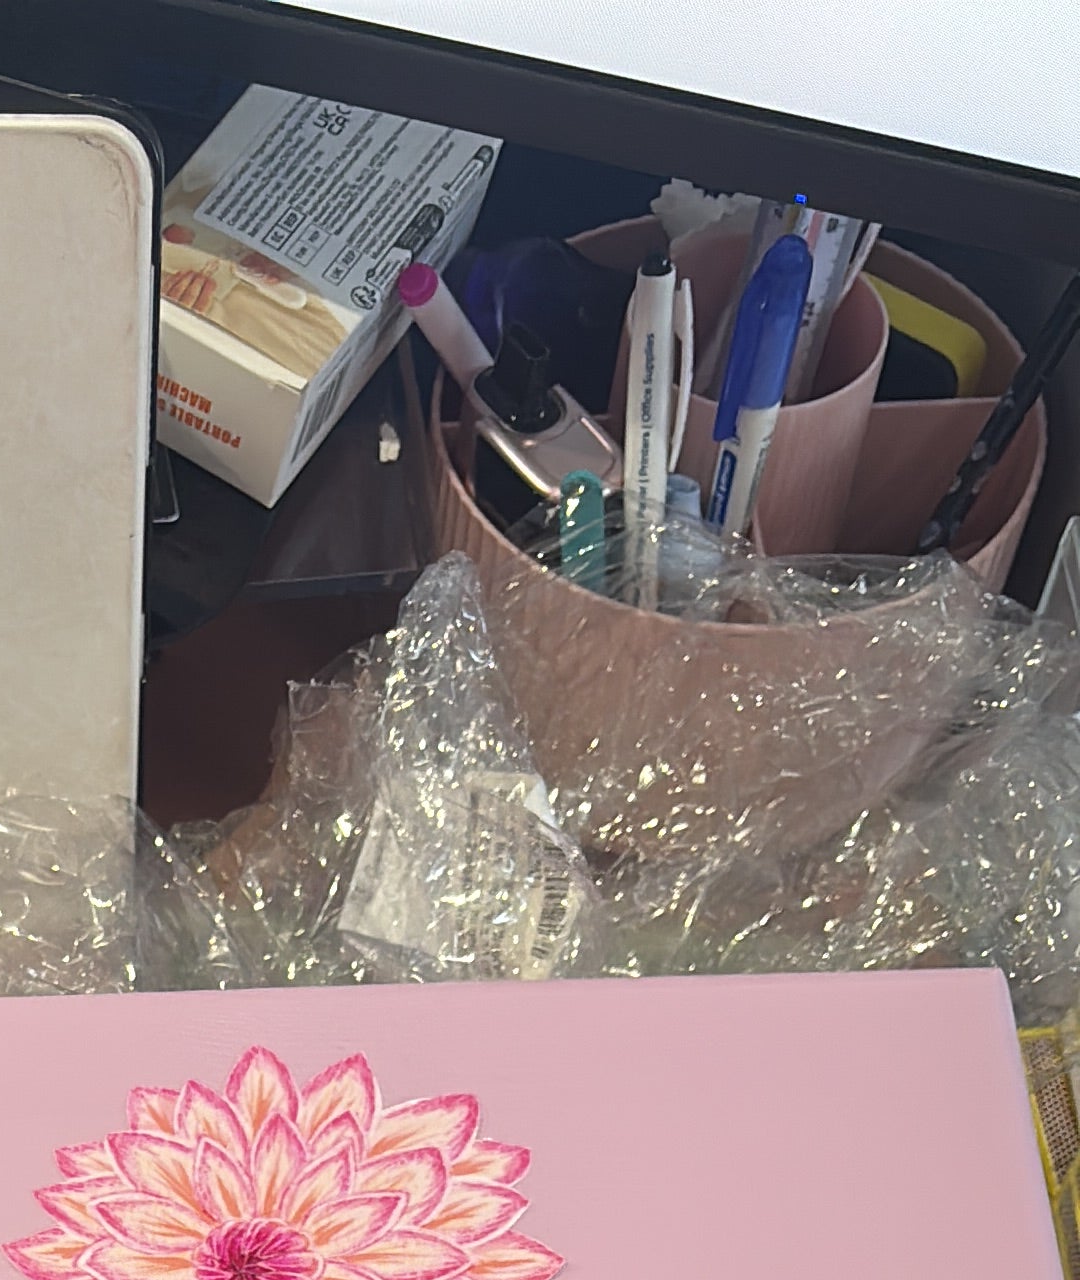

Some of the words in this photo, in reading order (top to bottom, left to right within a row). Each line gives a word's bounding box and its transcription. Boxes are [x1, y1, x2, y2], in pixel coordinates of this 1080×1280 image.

[313, 107, 336, 128] UK
[642, 333, 655, 385] Supplies
[169, 403, 241, 448] PORTABLE
[641, 386, 653, 422] Office
[639, 431, 651, 476] Printers
